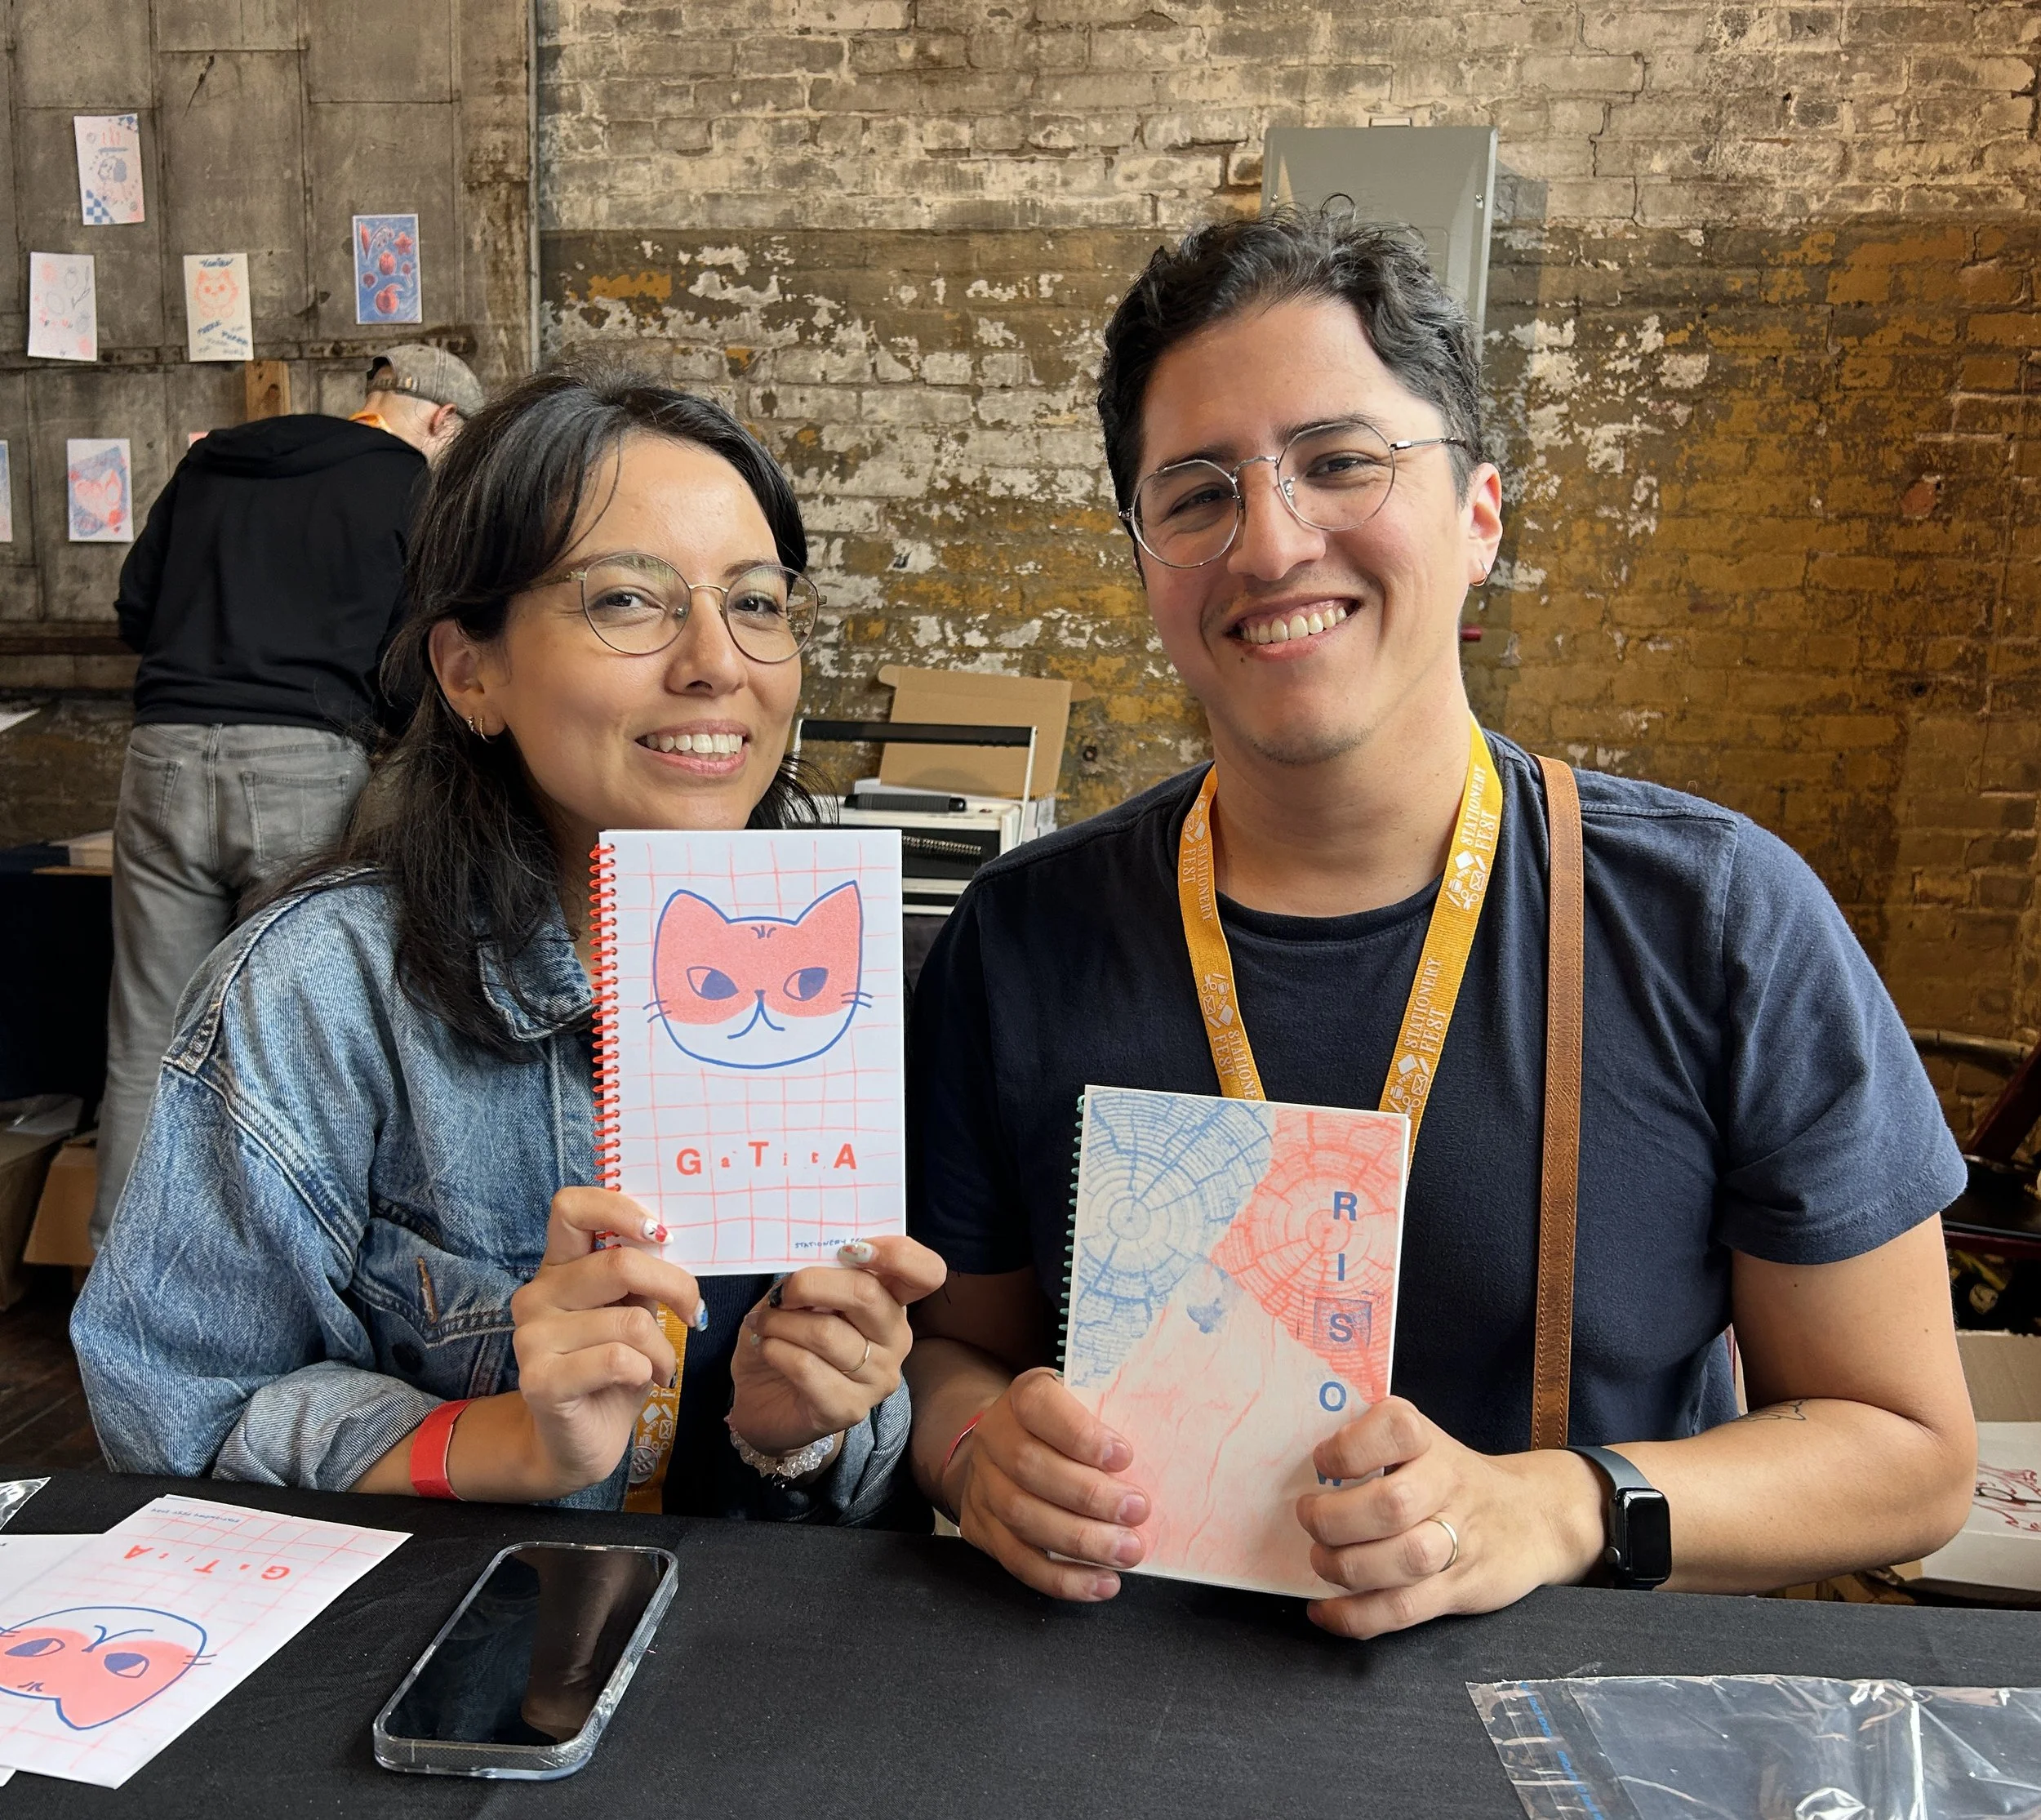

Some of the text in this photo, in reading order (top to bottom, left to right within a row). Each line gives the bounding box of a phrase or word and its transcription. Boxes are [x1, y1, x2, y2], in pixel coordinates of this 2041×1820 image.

[1460, 764, 1487, 846] STATIONERY
[1474, 810, 1497, 852] FEST
[1182, 848, 1197, 883] FEST
[1198, 843, 1214, 922] STATIONERY
[1403, 956, 1442, 1048] STATIONERY
[1419, 1007, 1447, 1054] FEST
[1213, 1034, 1235, 1075] FEST
[1227, 1030, 1258, 1099] STATIONE
